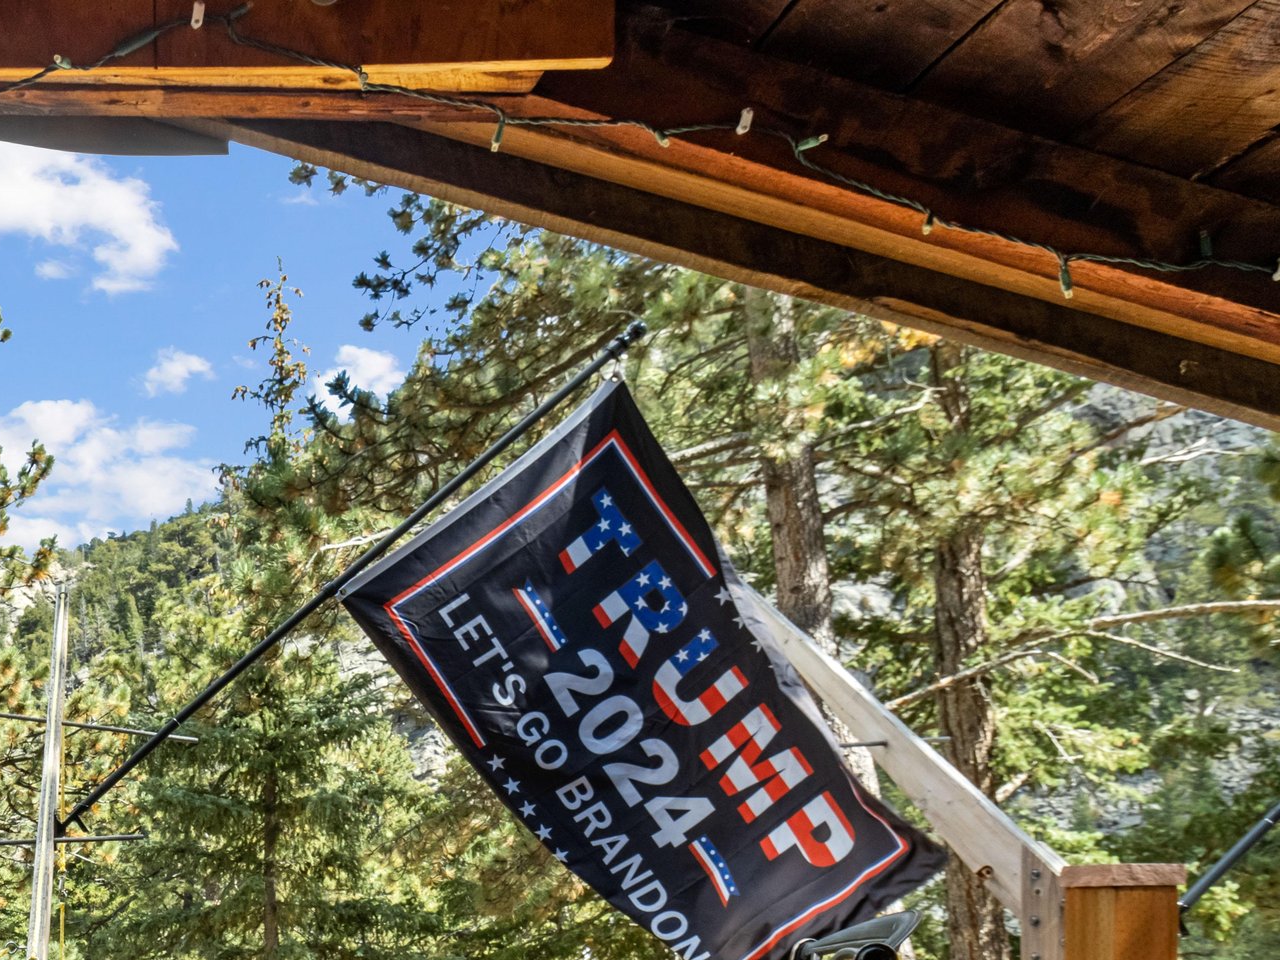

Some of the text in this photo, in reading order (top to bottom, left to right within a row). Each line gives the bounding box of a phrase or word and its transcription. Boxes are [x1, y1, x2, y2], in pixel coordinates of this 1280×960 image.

[438, 593, 527, 707] LET'S
[516, 711, 568, 771] GO
[543, 648, 716, 849] 2024
[558, 488, 856, 868] TRUMP
